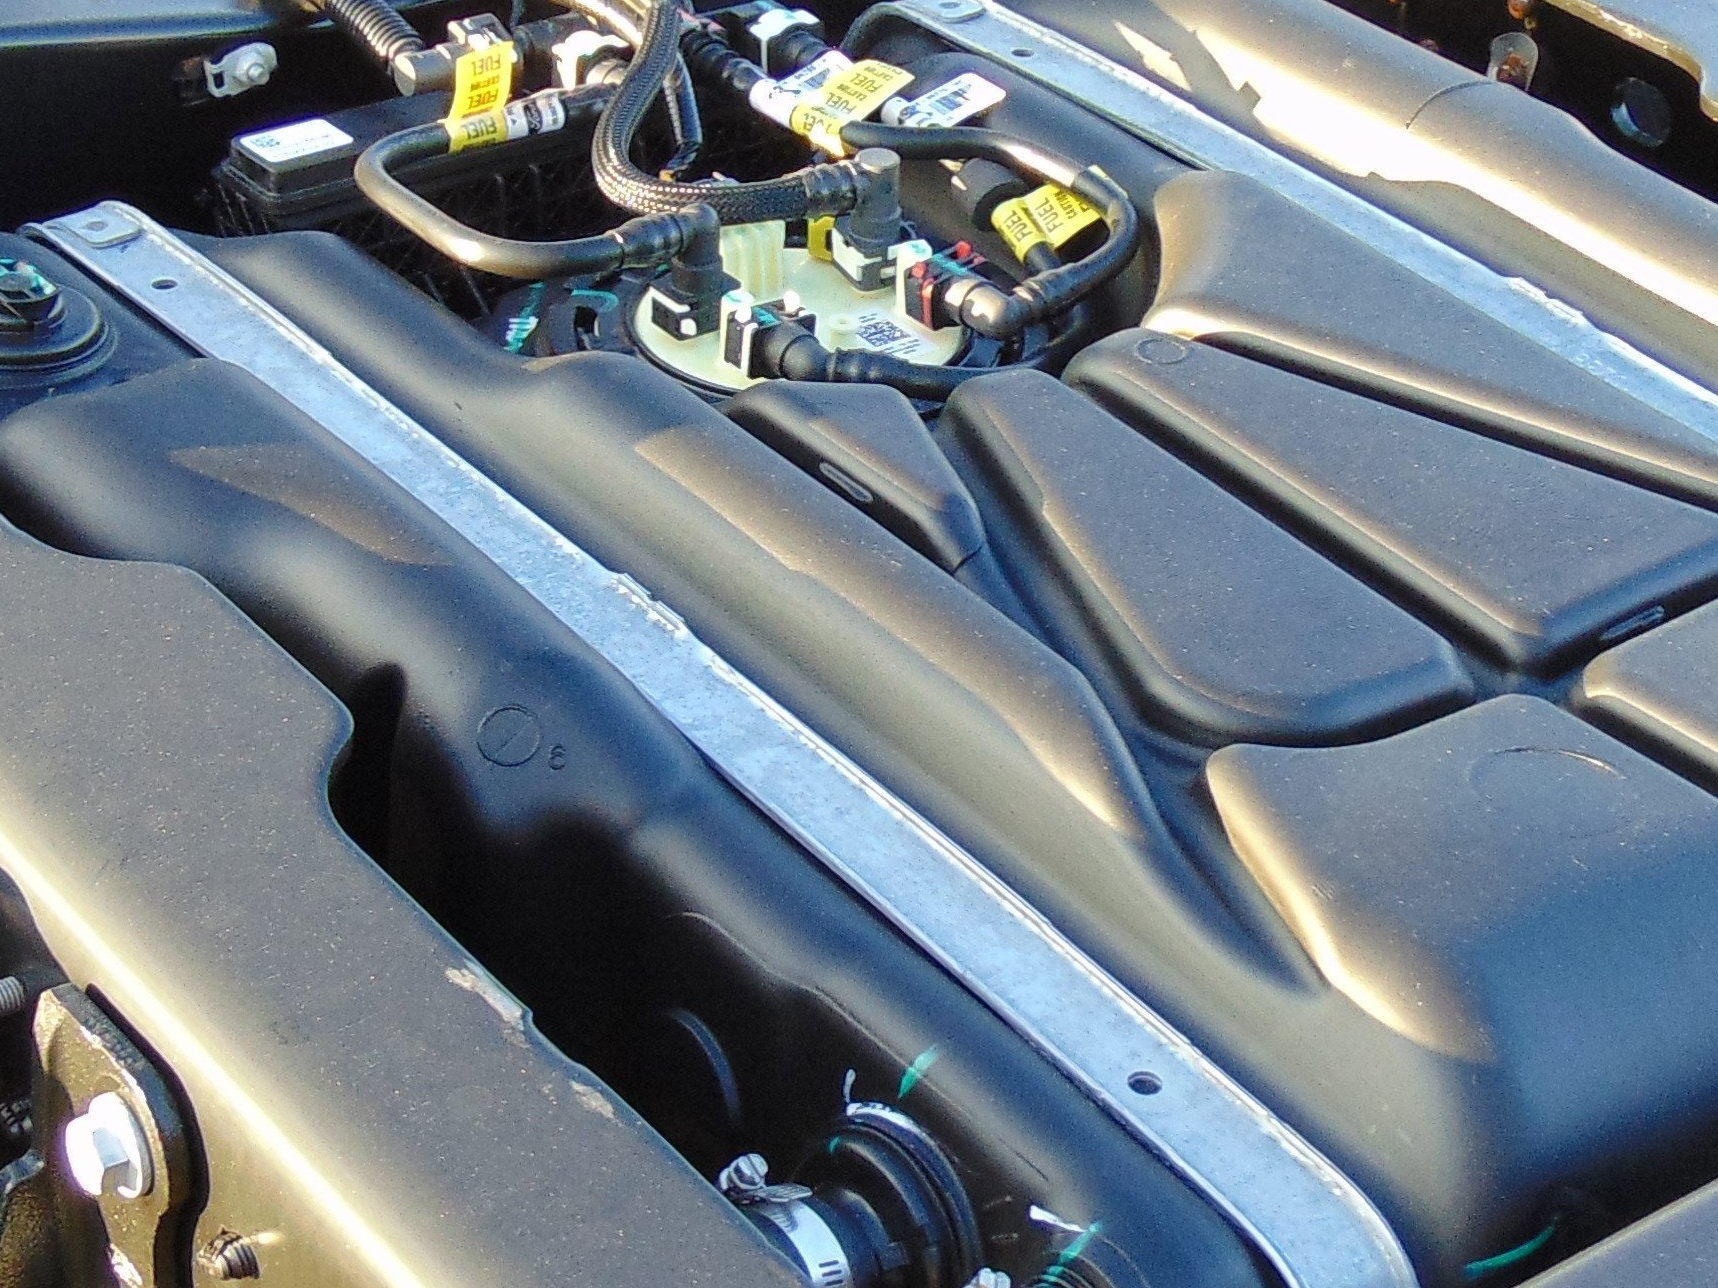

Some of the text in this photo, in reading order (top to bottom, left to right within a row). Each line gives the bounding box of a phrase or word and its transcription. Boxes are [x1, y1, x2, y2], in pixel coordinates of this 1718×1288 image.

[472, 53, 502, 76] FUEL
[849, 72, 883, 93] FUEL
[468, 88, 499, 110] FUEL
[825, 91, 857, 114] FUEL
[463, 116, 498, 140] FUEL
[1003, 209, 1033, 242] FUEL
[1034, 196, 1064, 234] FUEL
